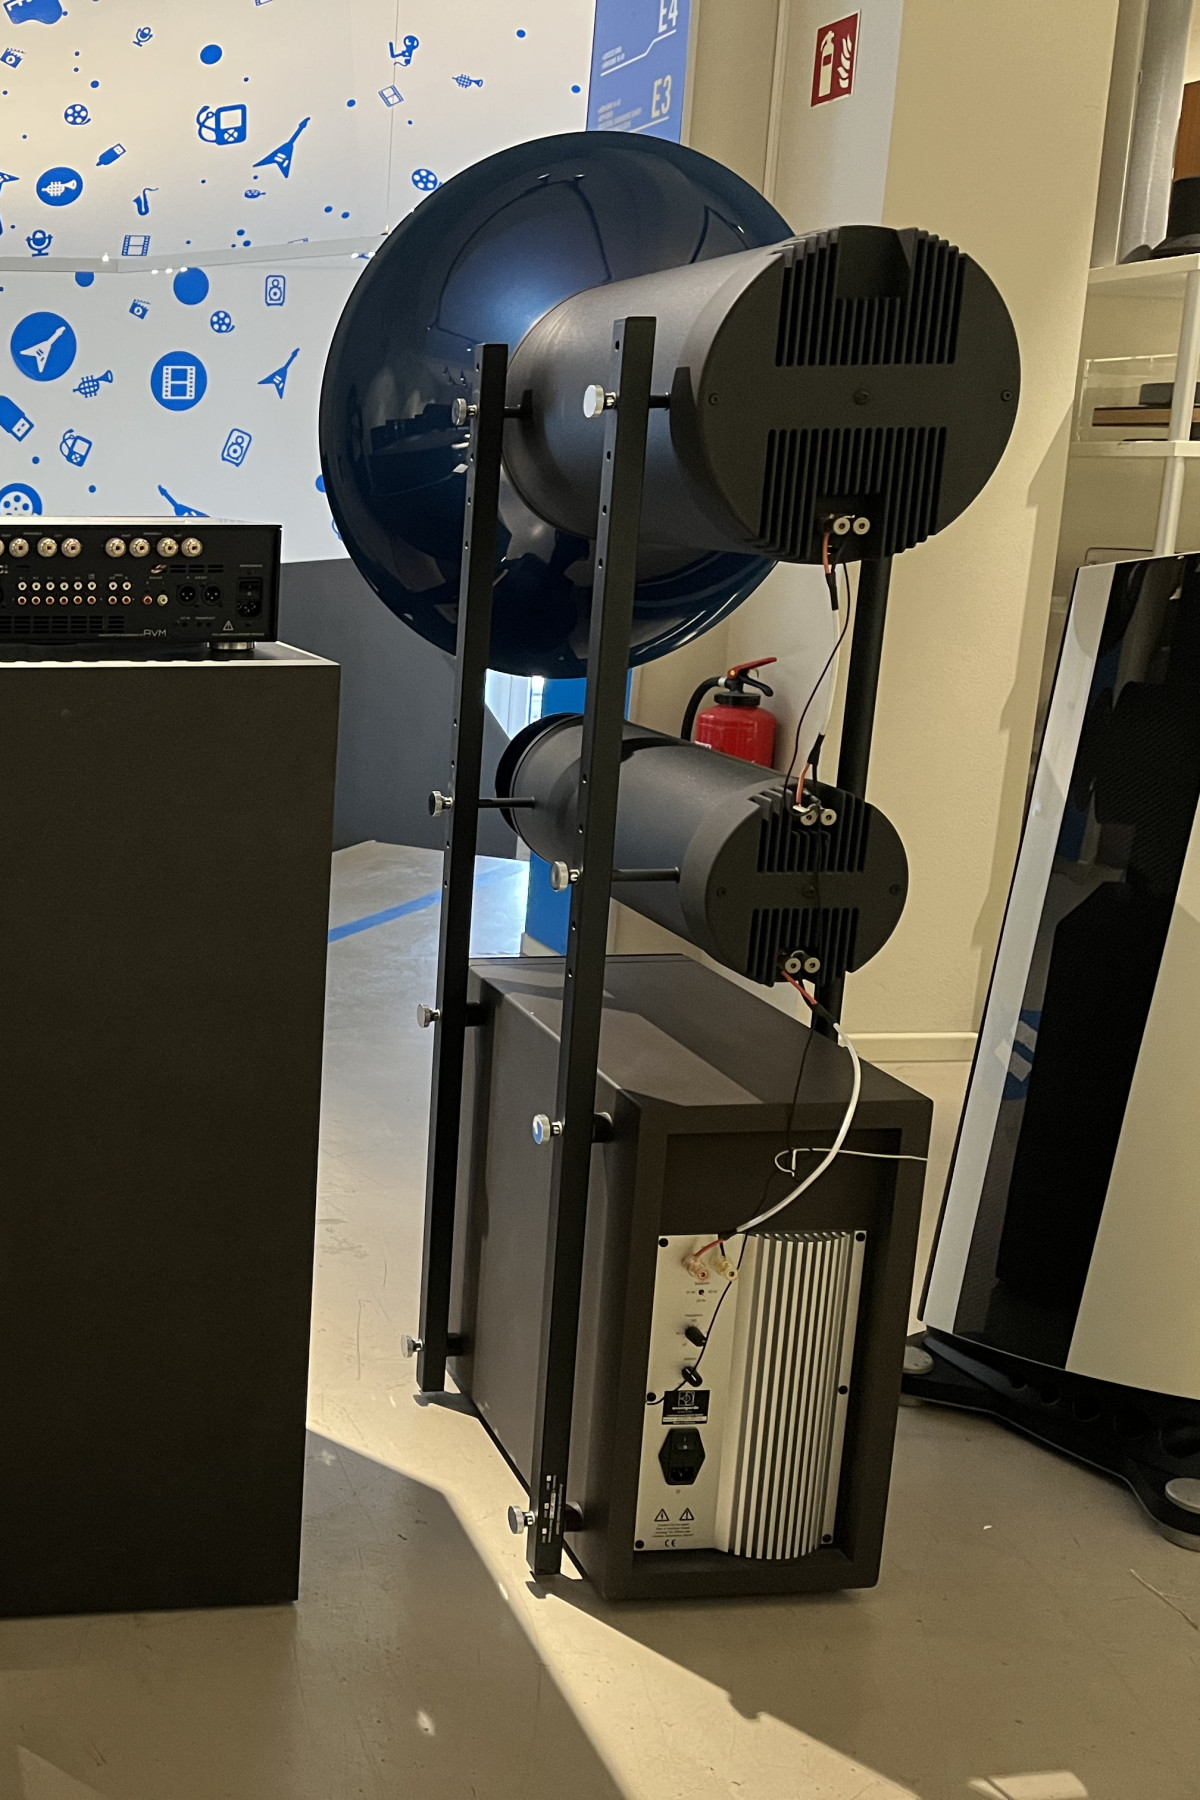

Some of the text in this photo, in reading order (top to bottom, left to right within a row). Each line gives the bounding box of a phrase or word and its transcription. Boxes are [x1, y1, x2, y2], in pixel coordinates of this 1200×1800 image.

[658, 0, 679, 34] E4
[651, 74, 673, 119] E3
[143, 629, 167, 638] AVM
